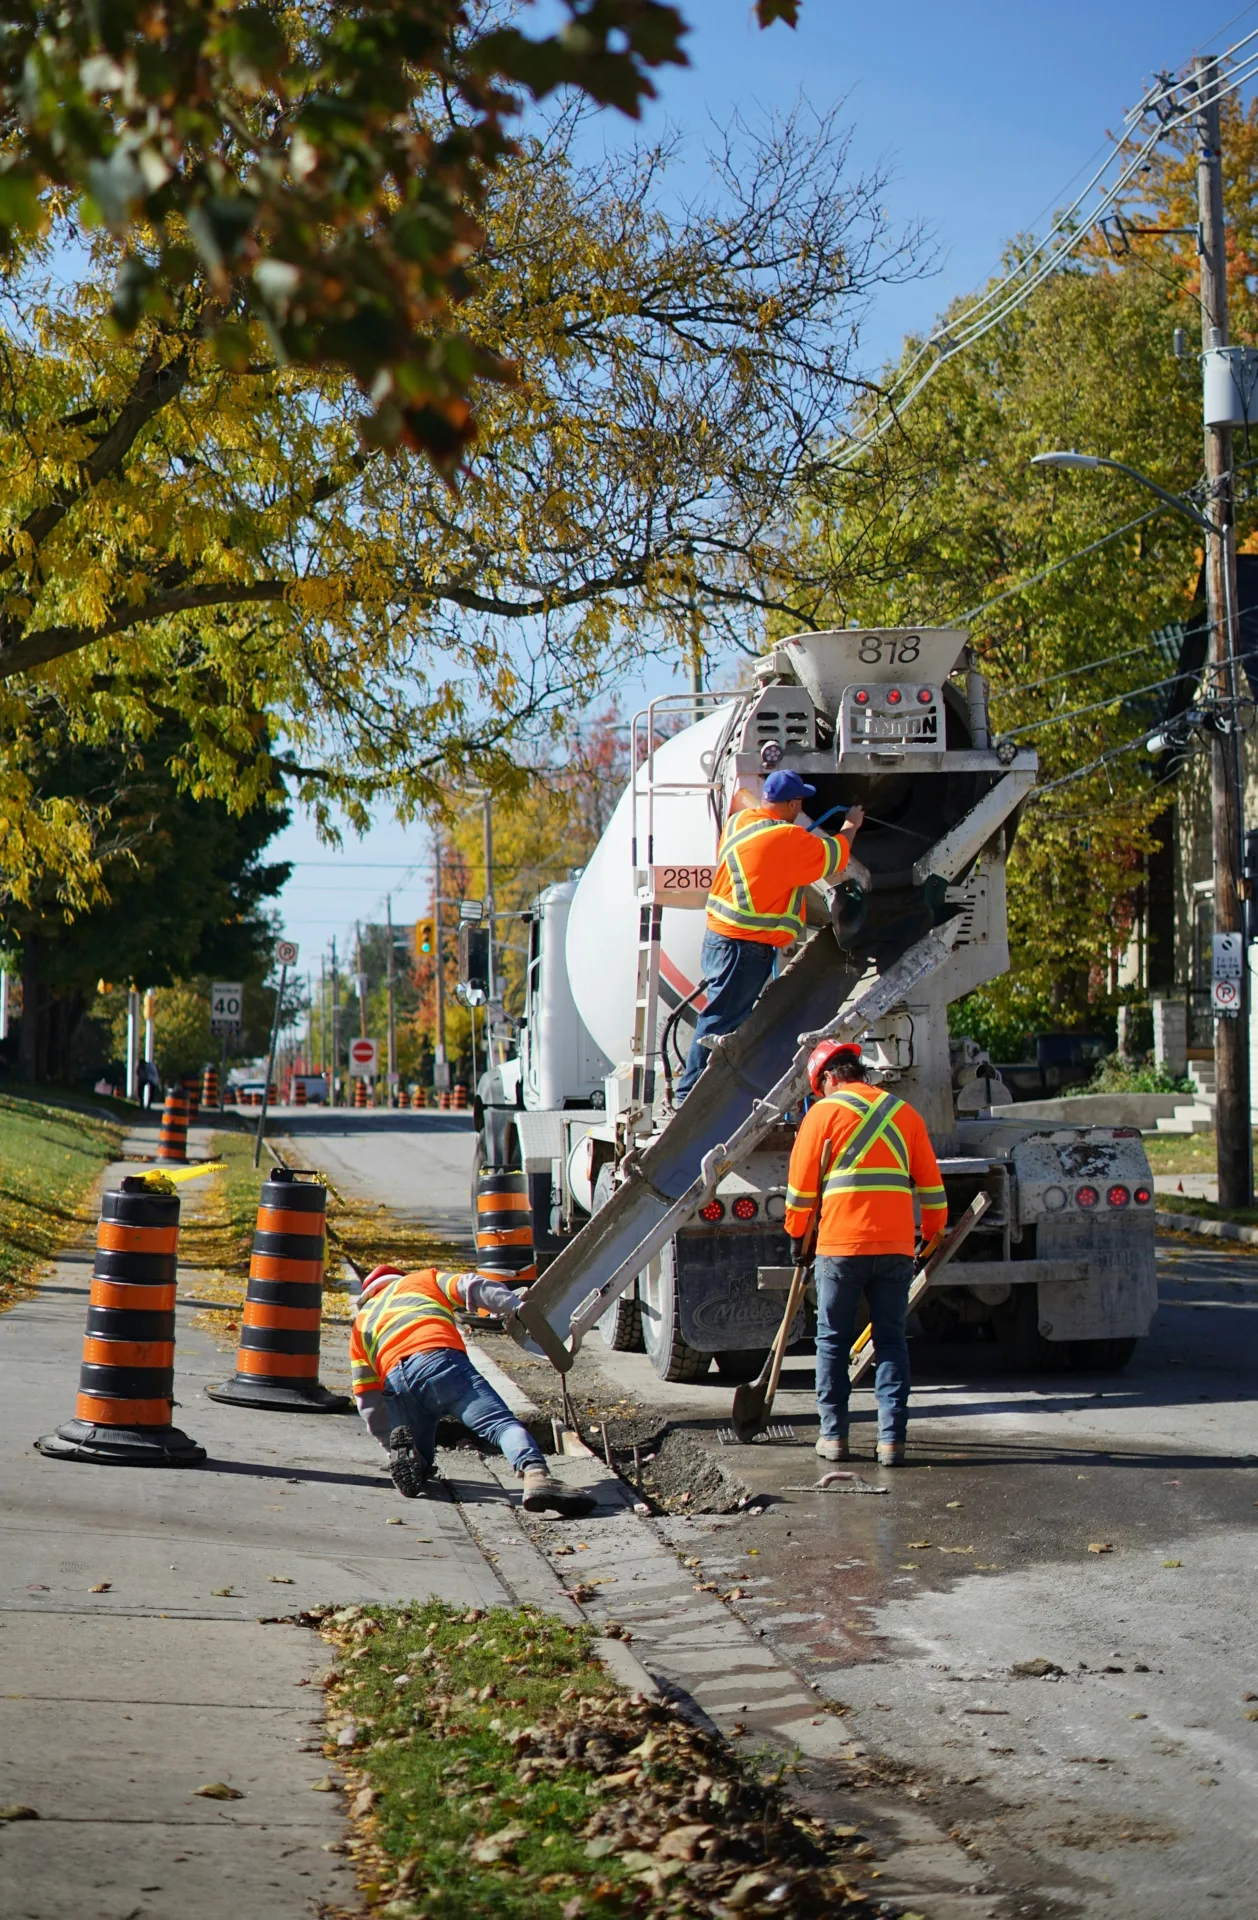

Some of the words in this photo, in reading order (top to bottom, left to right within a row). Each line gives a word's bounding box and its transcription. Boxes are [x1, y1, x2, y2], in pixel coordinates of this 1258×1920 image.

[858, 635, 921, 664] 818
[663, 868, 713, 889] 2818
[214, 997, 239, 1016] 40
